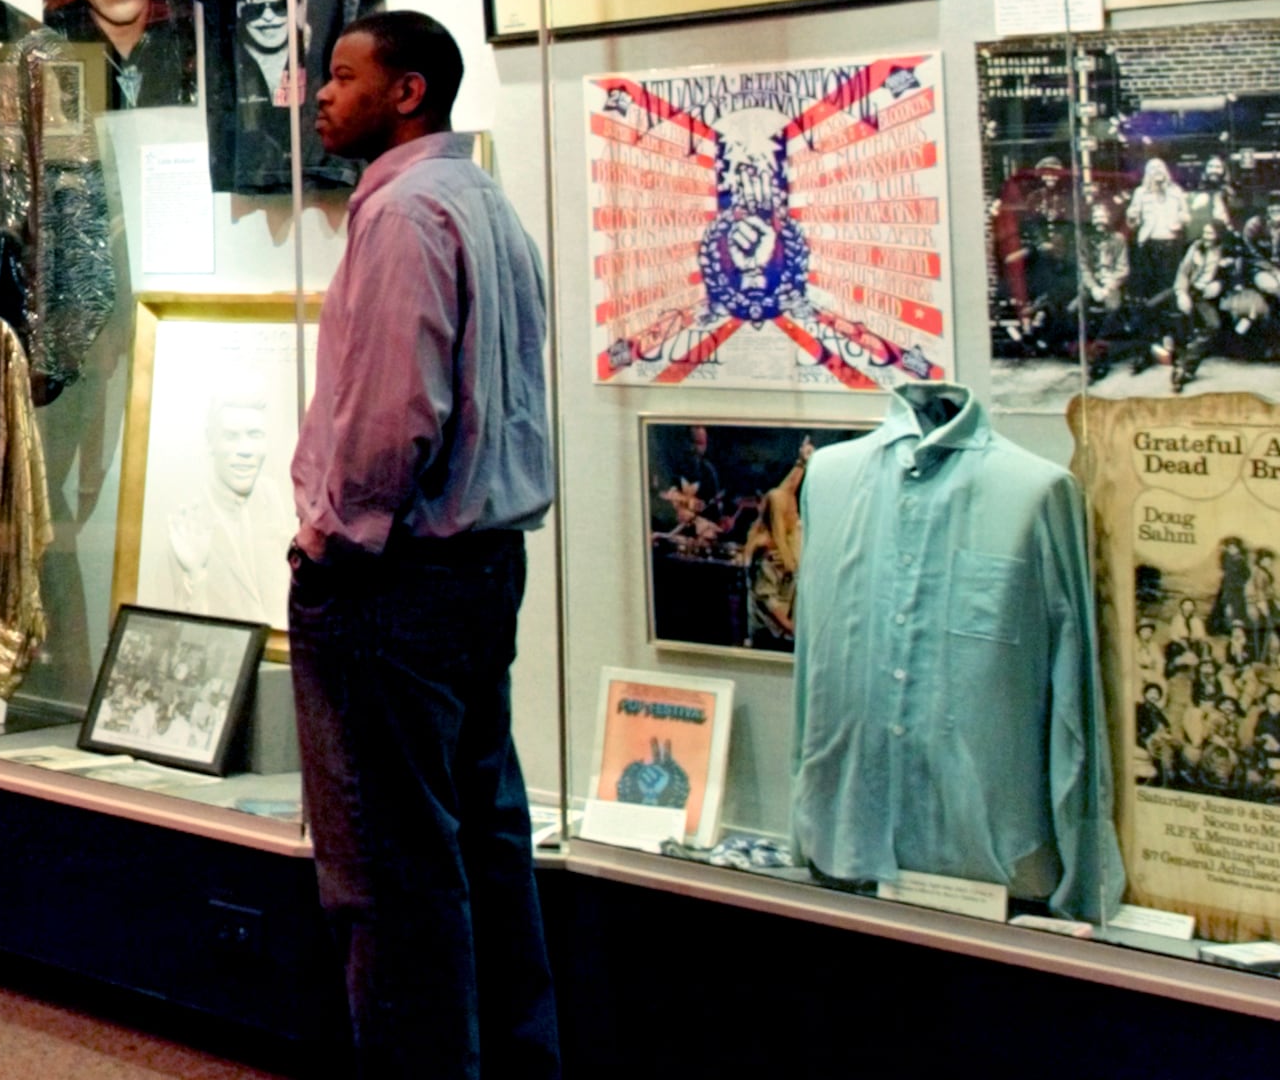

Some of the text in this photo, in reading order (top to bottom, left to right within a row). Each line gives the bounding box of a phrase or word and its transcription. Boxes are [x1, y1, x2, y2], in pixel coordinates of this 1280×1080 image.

[1134, 431, 1243, 455] Grateful
[1144, 454, 1280, 480] Dead Br
[1144, 506, 1196, 531] Doug
[1138, 524, 1197, 545] Sahm
[1137, 788, 1200, 813] Saturday
[1202, 800, 1235, 817] June
[1203, 815, 1240, 832] Noon
[1243, 823, 1260, 834] to
[1205, 829, 1275, 854] Memorial
[1160, 850, 1216, 871] General
